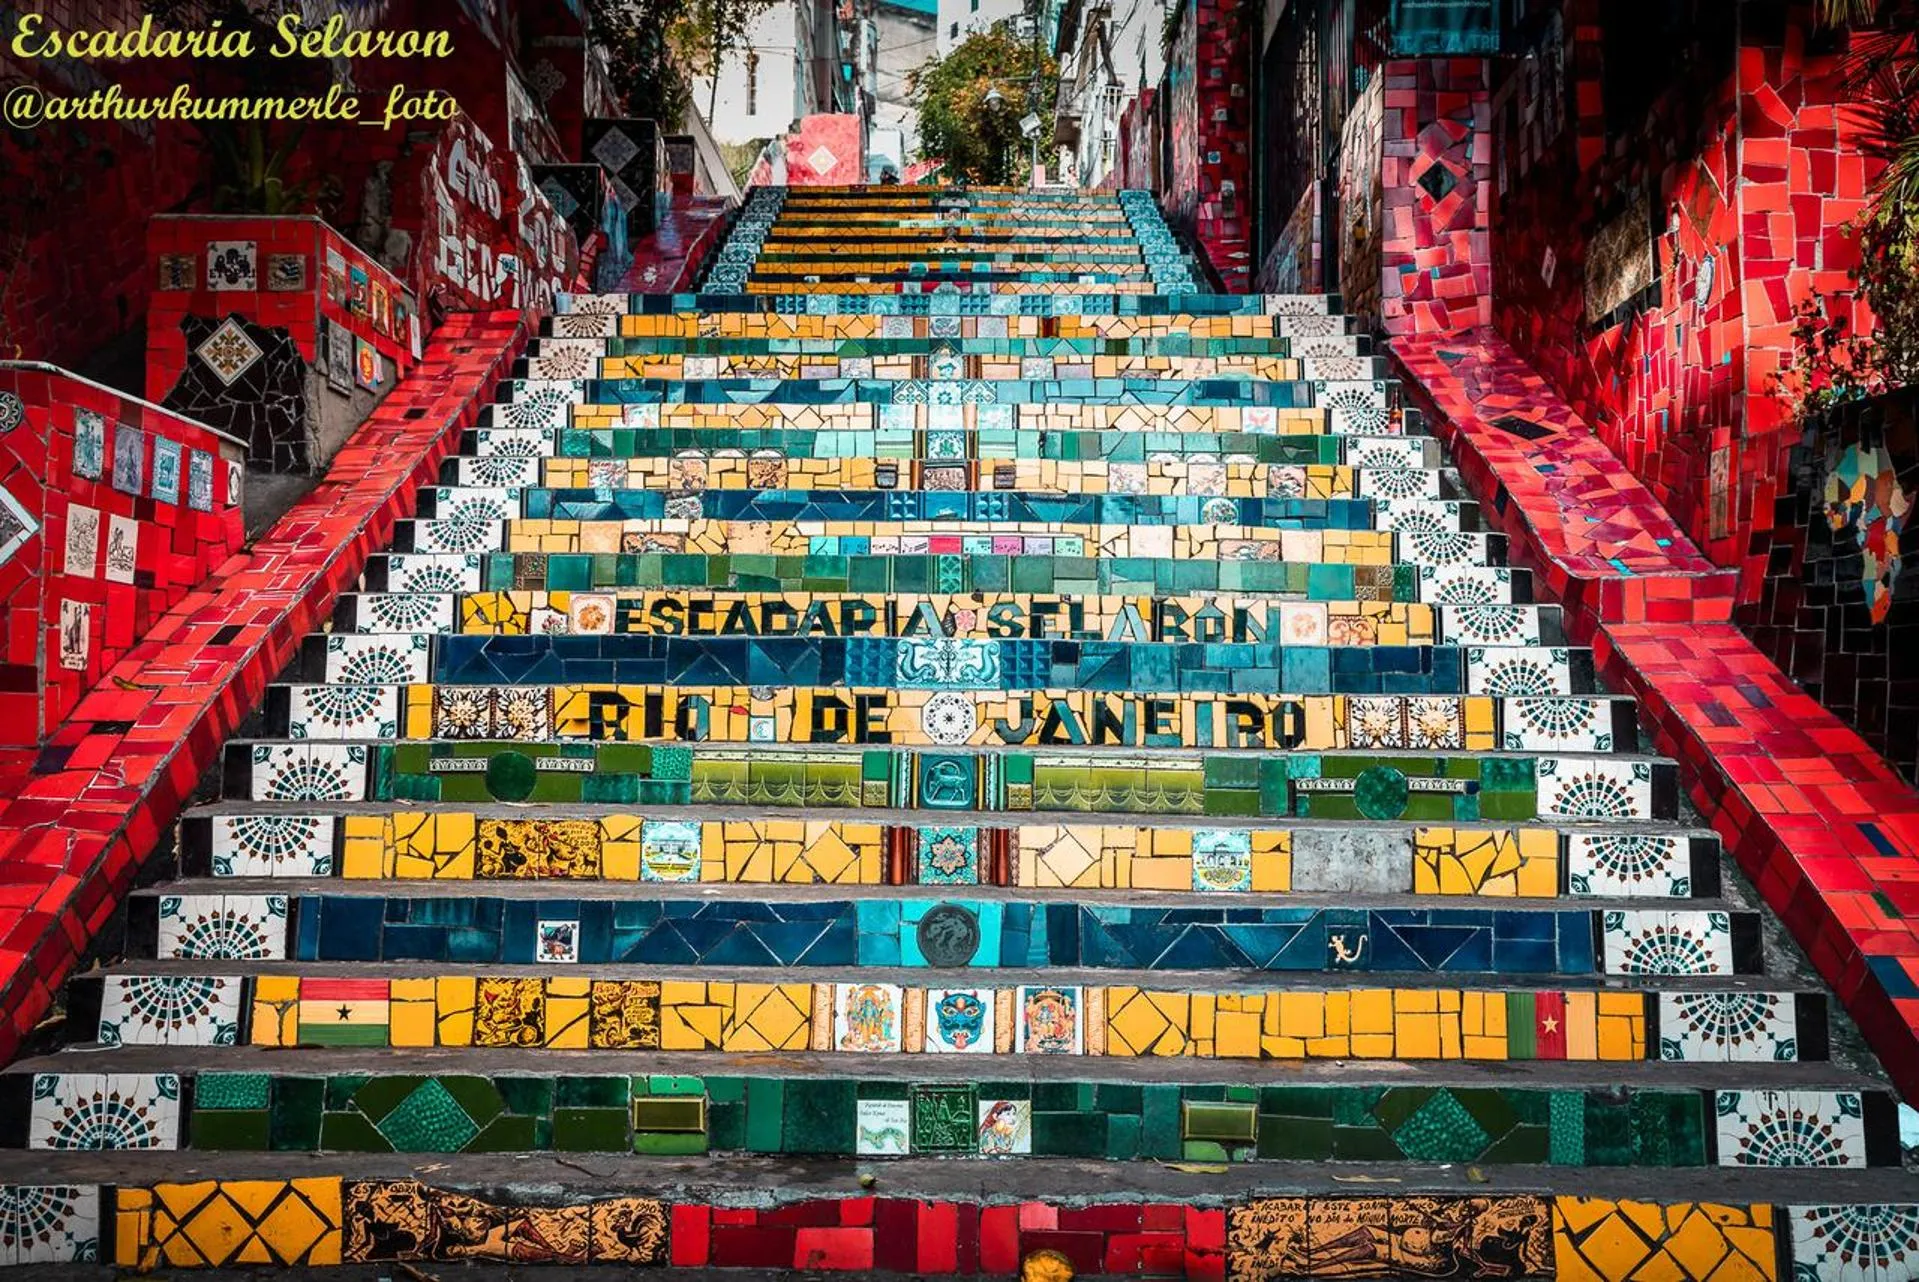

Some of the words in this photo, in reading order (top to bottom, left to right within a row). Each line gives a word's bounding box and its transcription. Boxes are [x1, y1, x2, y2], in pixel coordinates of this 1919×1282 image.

[589, 692, 711, 741] RIO
[811, 694, 893, 743] DE
[994, 697, 1306, 750] JANEIRO
